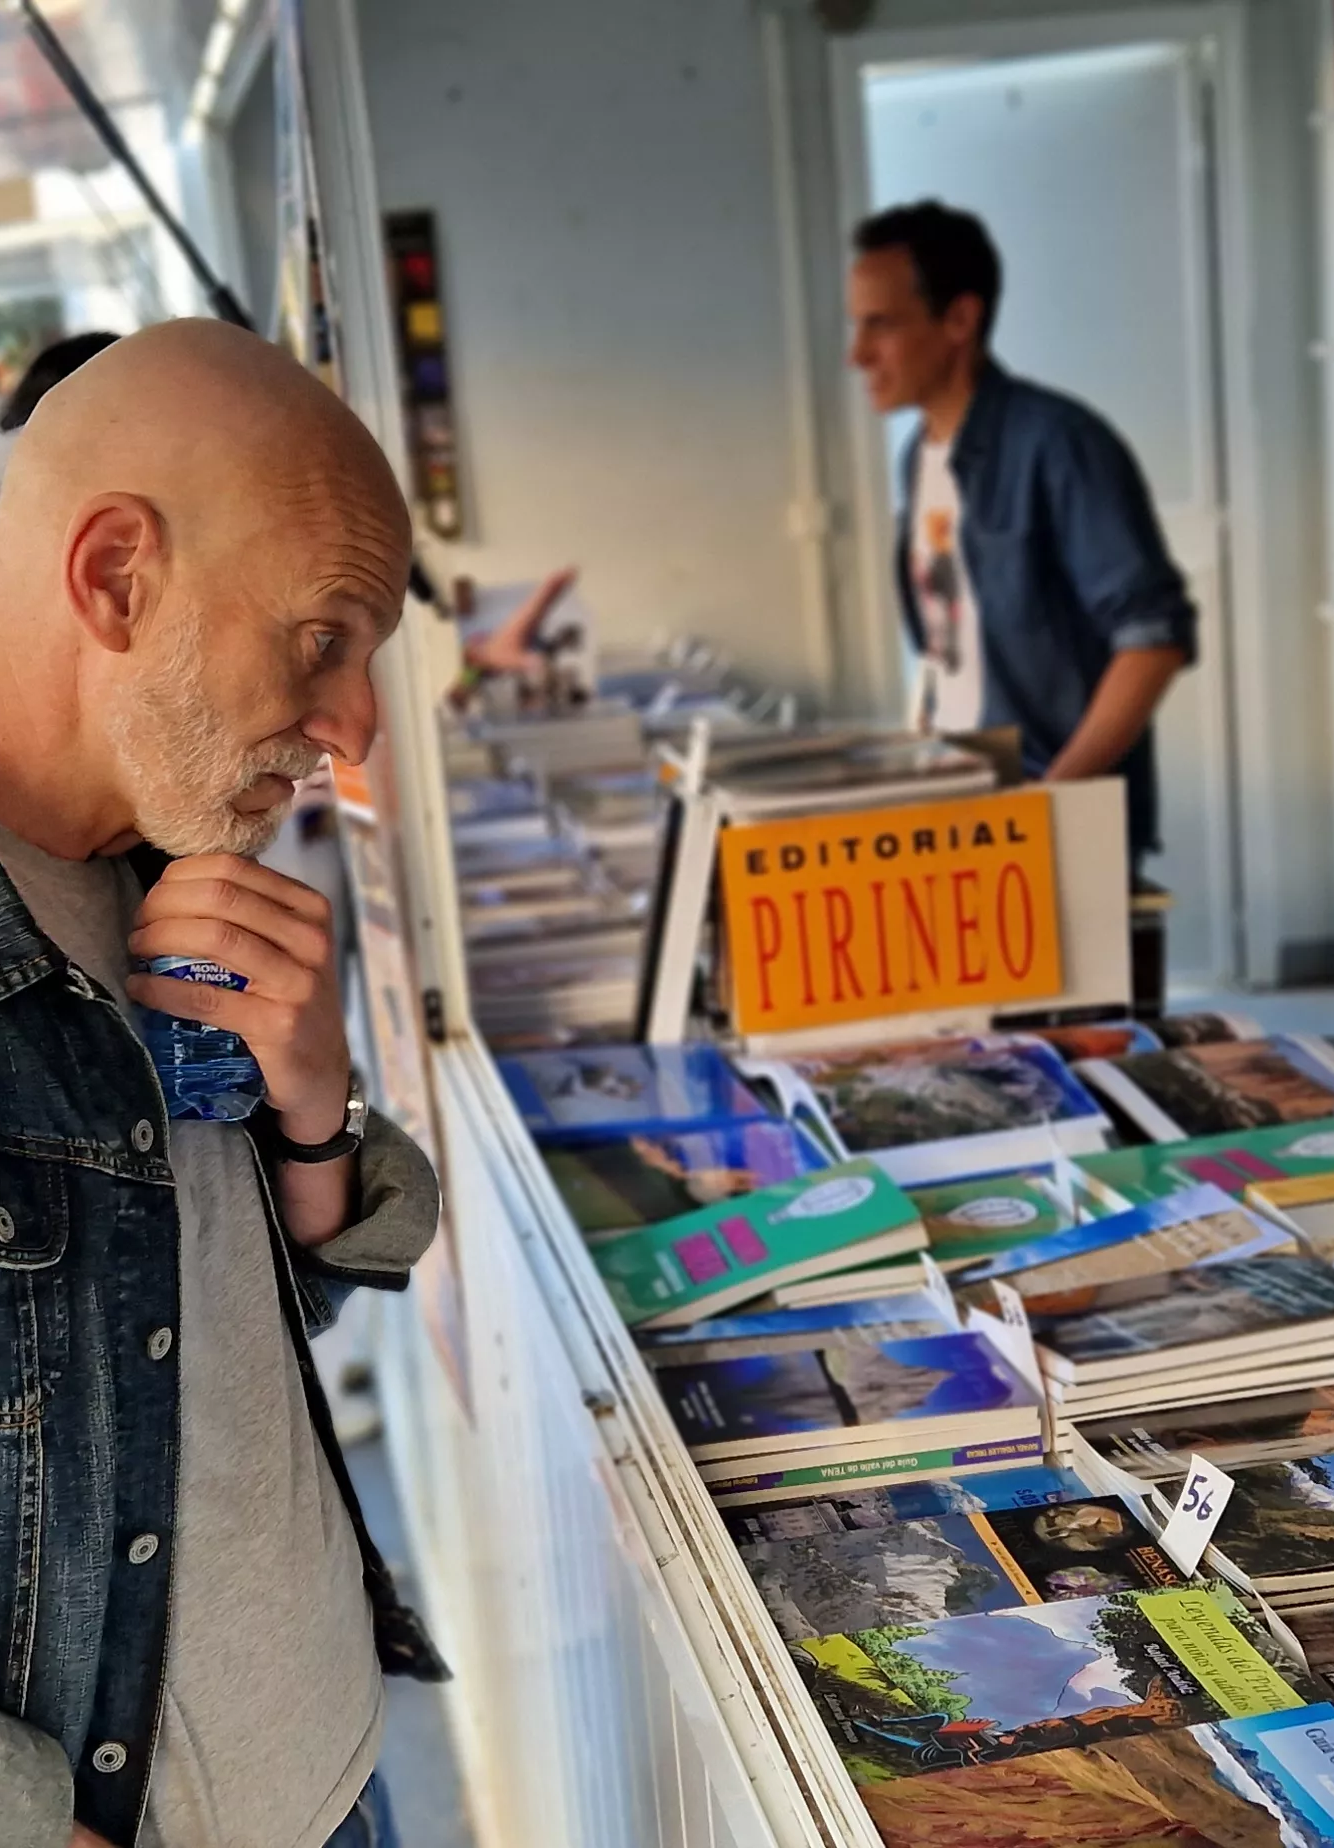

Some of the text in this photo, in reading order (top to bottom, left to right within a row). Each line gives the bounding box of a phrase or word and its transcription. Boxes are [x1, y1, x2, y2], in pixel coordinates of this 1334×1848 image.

[746, 818, 1027, 876] EDITORIAL
[749, 860, 1035, 1013] PIRINEO
[194, 972, 232, 983] PINOS
[820, 1465, 847, 1477] TENA
[1154, 1616, 1188, 1642] para
[1179, 1600, 1240, 1655] Leyendas
[1227, 1654, 1259, 1675] del
